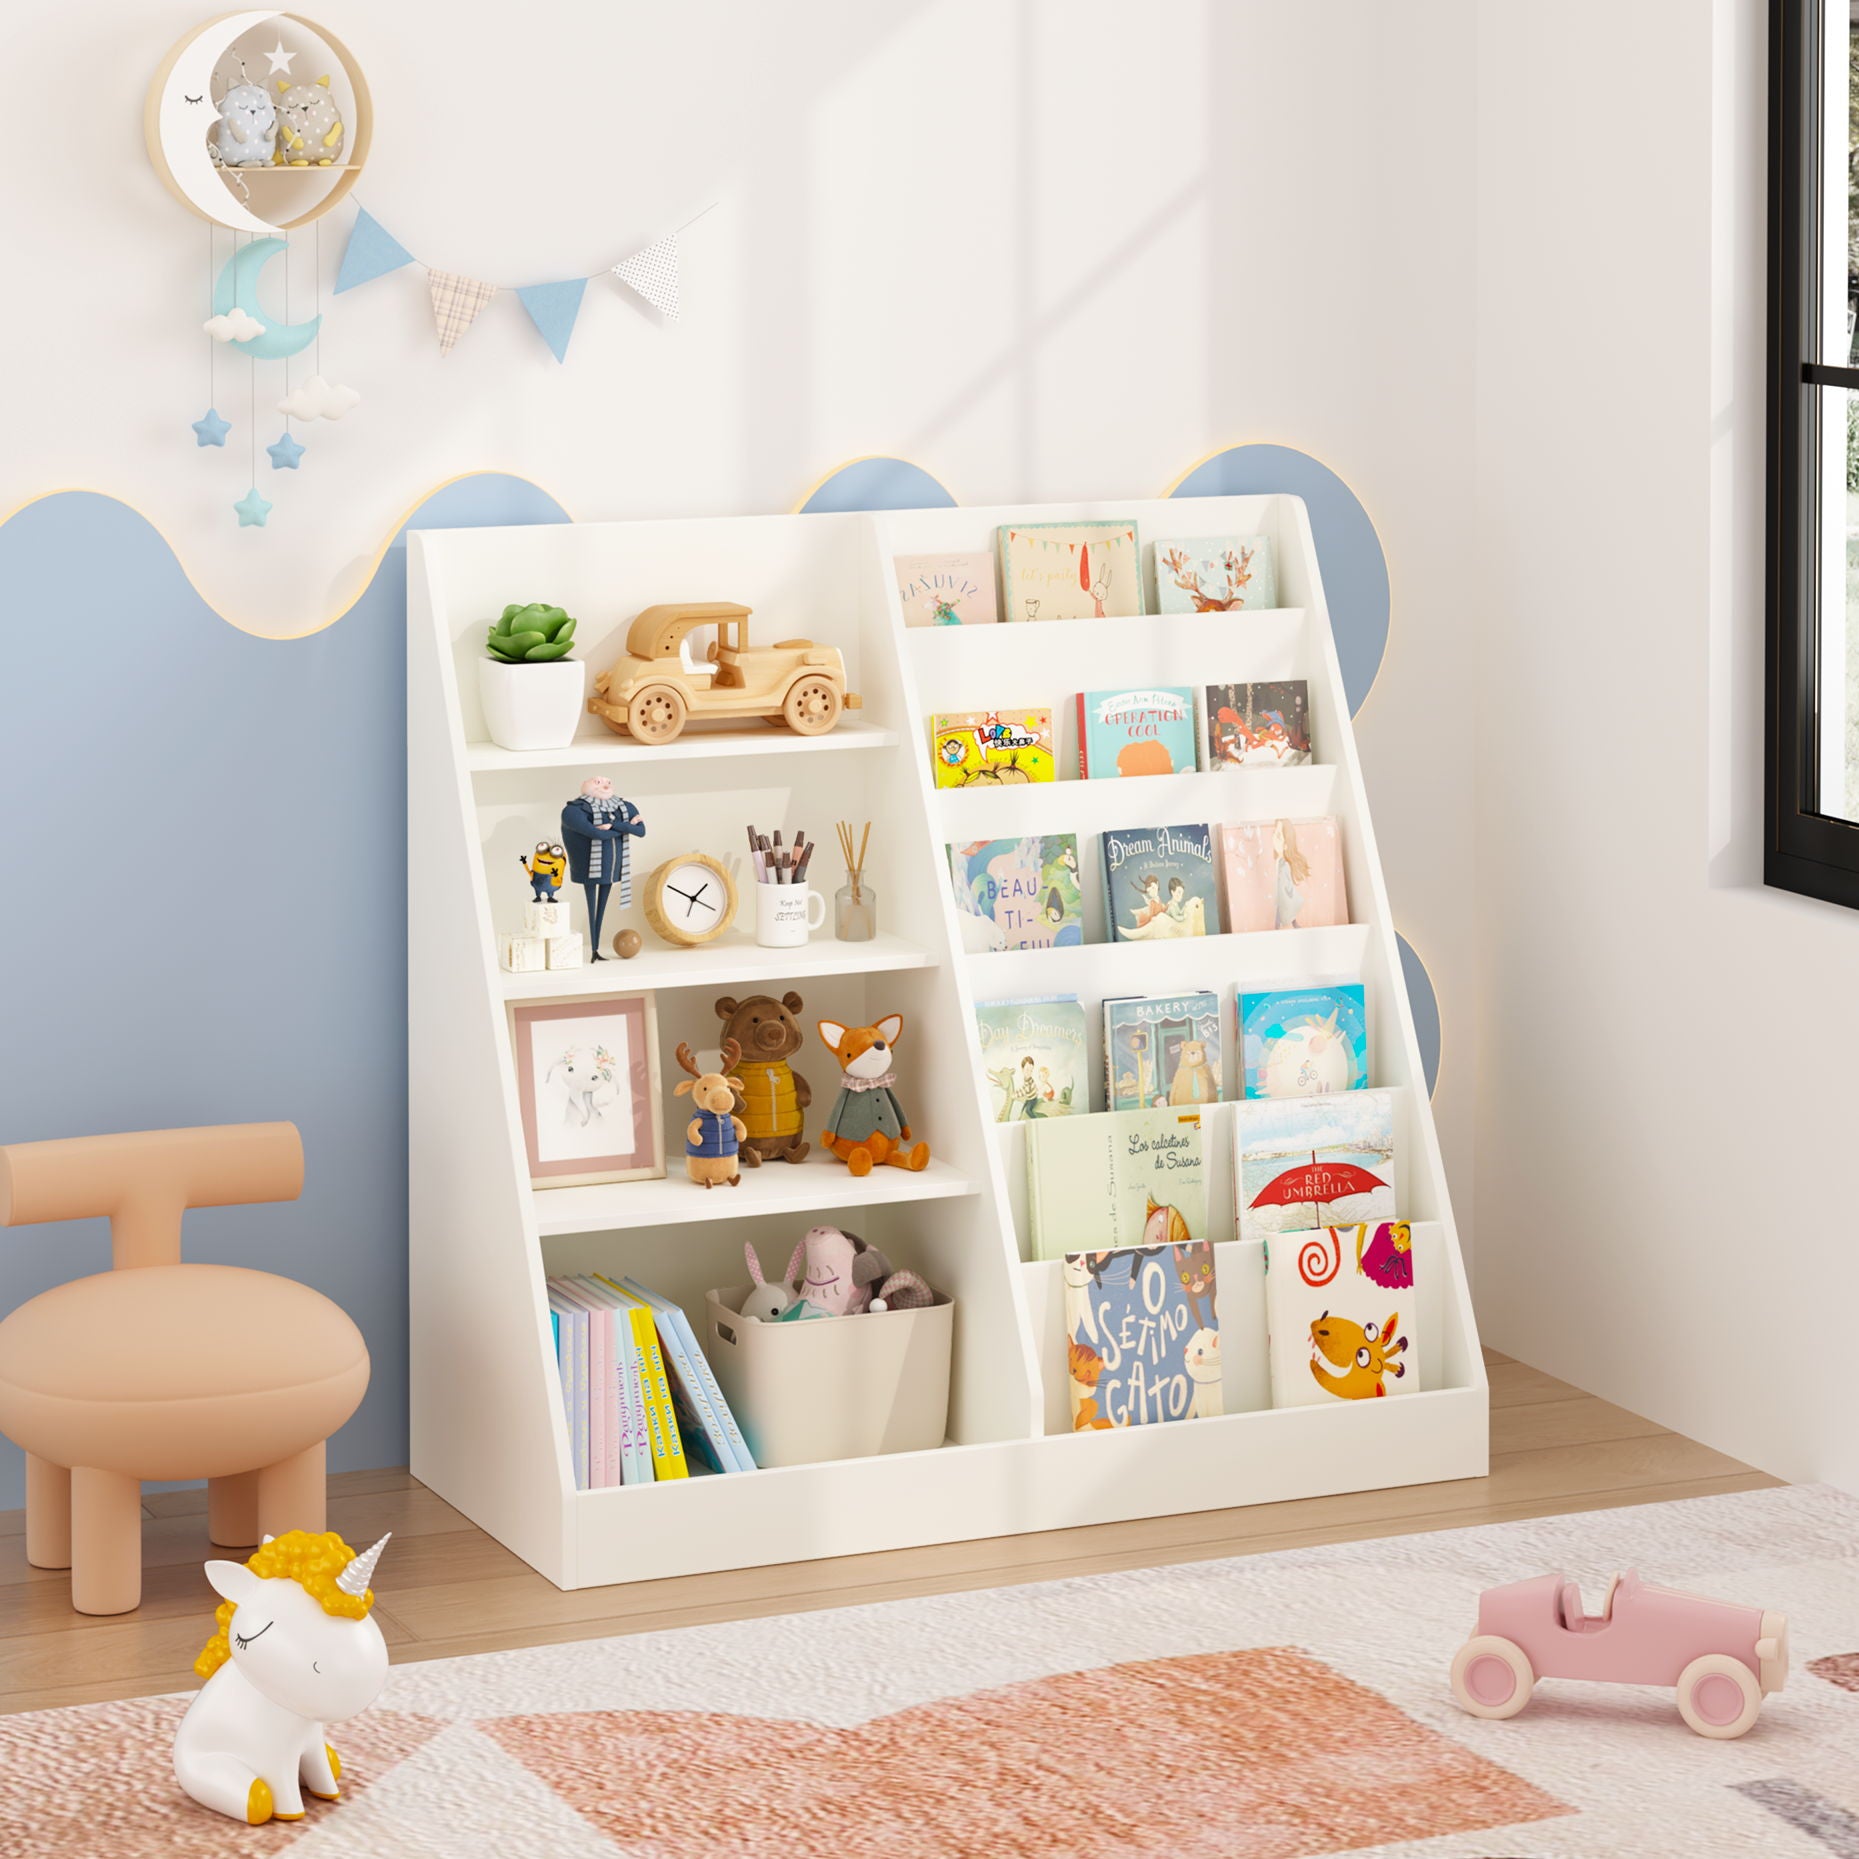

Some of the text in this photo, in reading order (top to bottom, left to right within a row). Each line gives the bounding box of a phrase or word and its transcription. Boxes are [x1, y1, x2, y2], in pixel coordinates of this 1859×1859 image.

[1104, 709, 1184, 726] OPERATION
[1128, 724, 1160, 737] COOL
[1107, 826, 1212, 872] Dream Animals
[1136, 1001, 1190, 1017] BAKERY
[1016, 1011, 1082, 1048] Dreamers
[1128, 1132, 1190, 1156] Los calcetines
[1154, 1151, 1202, 1170] de Susana
[1311, 1165, 1324, 1173] THE
[1305, 1172, 1332, 1186] RED
[1282, 1181, 1356, 1200] UMBRELLA
[1142, 1261, 1166, 1315] O
[642, 1378, 653, 1400] на
[657, 1377, 668, 1399] на
[1105, 1361, 1188, 1427] GATO
